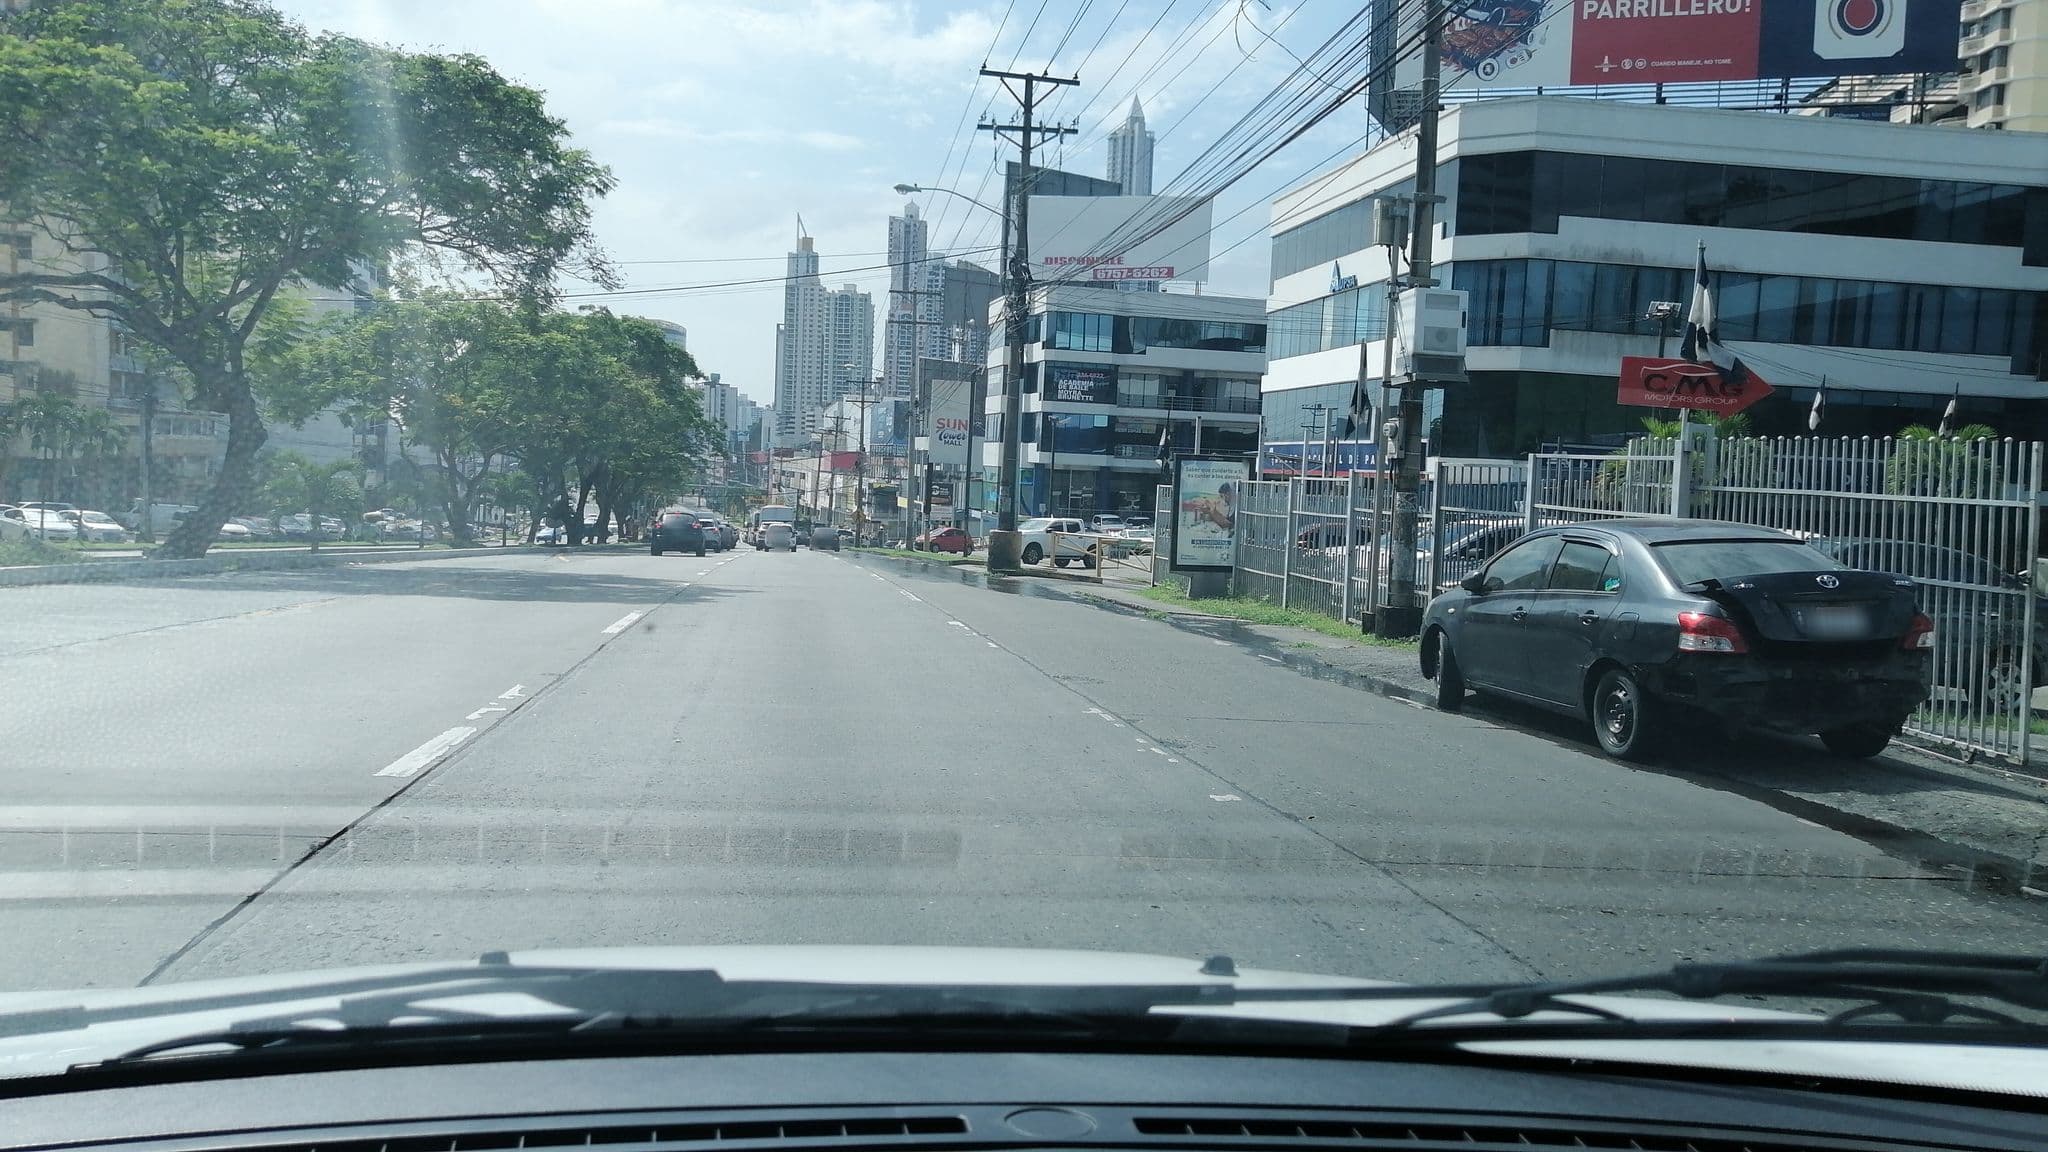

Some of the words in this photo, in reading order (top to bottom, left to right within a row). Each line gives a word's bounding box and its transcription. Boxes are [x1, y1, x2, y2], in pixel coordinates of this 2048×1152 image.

[1058, 379, 1094, 387] ACADEMIA
[1057, 393, 1094, 401] BRUNETTE
[1644, 393, 1691, 404] MOTORS
[1694, 396, 1738, 406] GROUP
[936, 418, 968, 431] SUN
